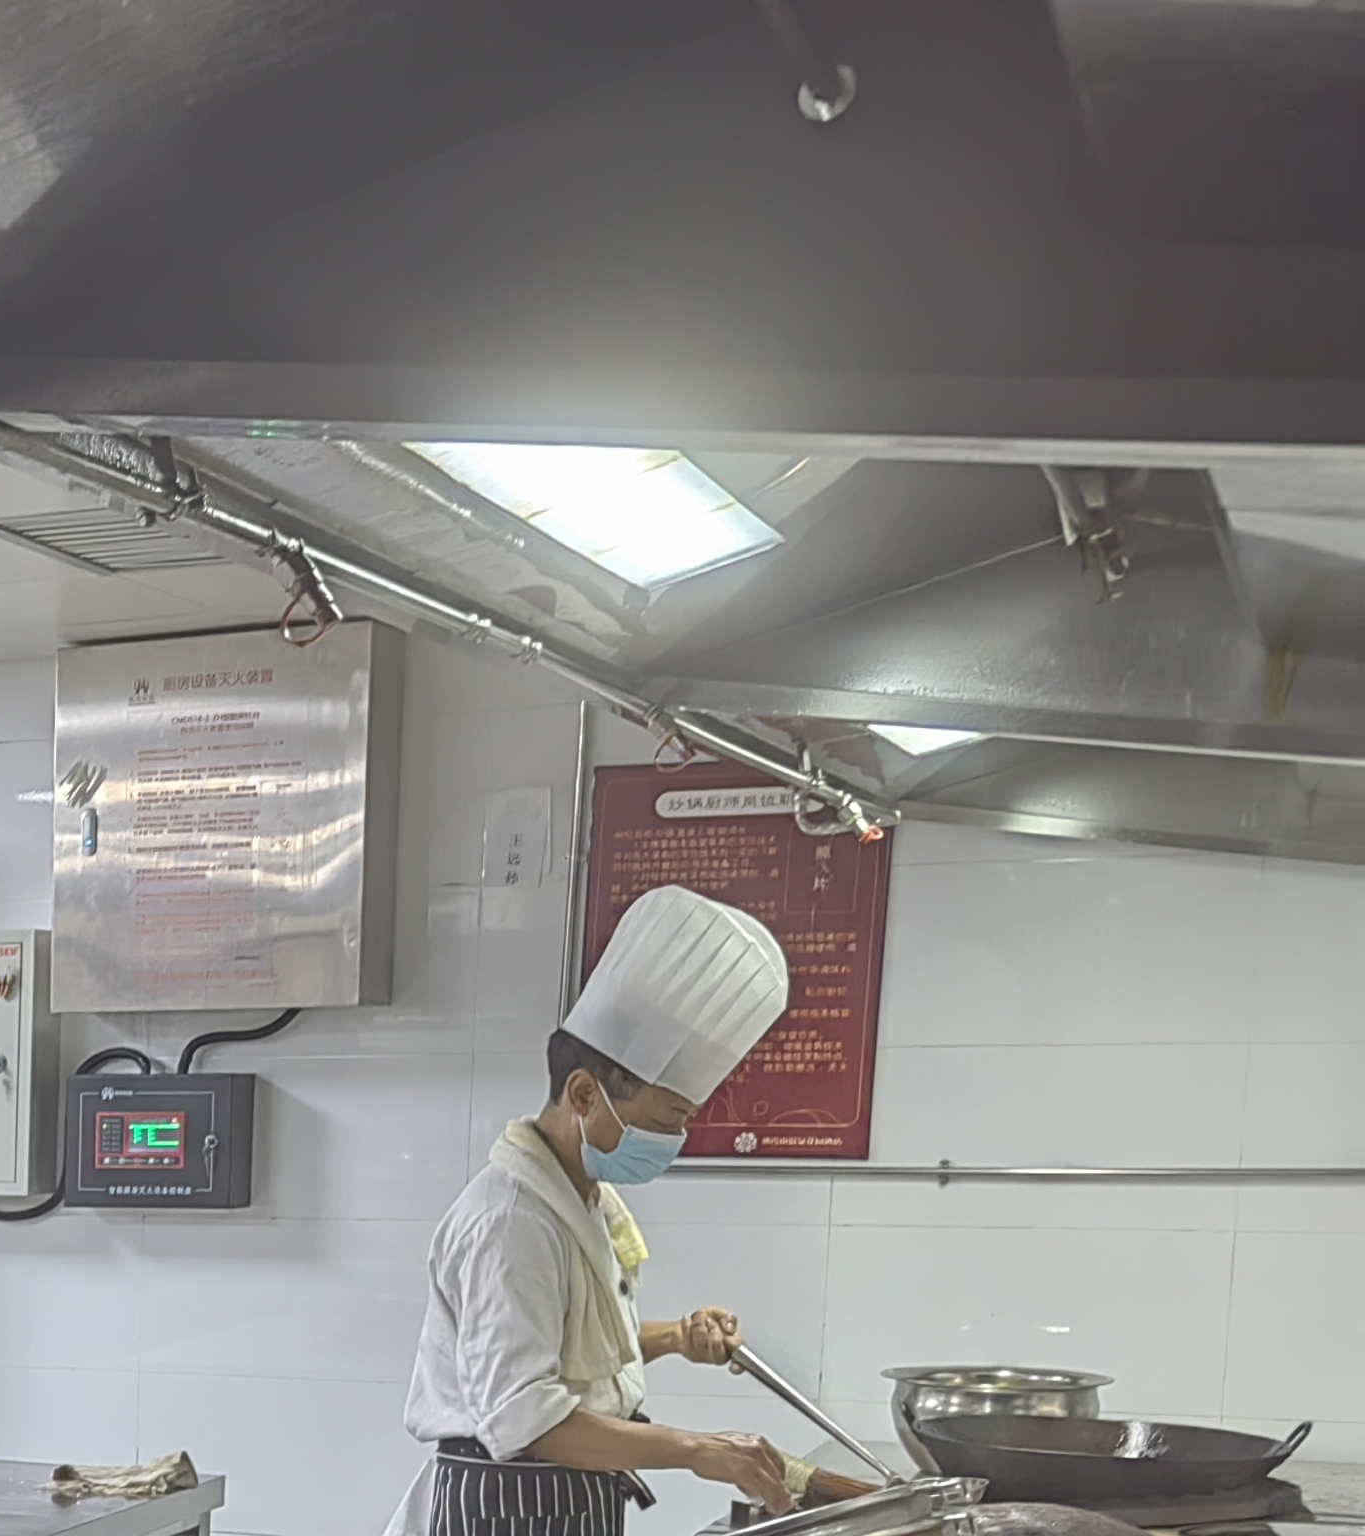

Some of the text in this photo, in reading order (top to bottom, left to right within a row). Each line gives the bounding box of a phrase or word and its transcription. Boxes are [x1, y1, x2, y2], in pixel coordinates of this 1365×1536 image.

[163, 668, 274, 692] 厨房设备灭火装置
[667, 793, 793, 811] 炒锅厨师岗位职
